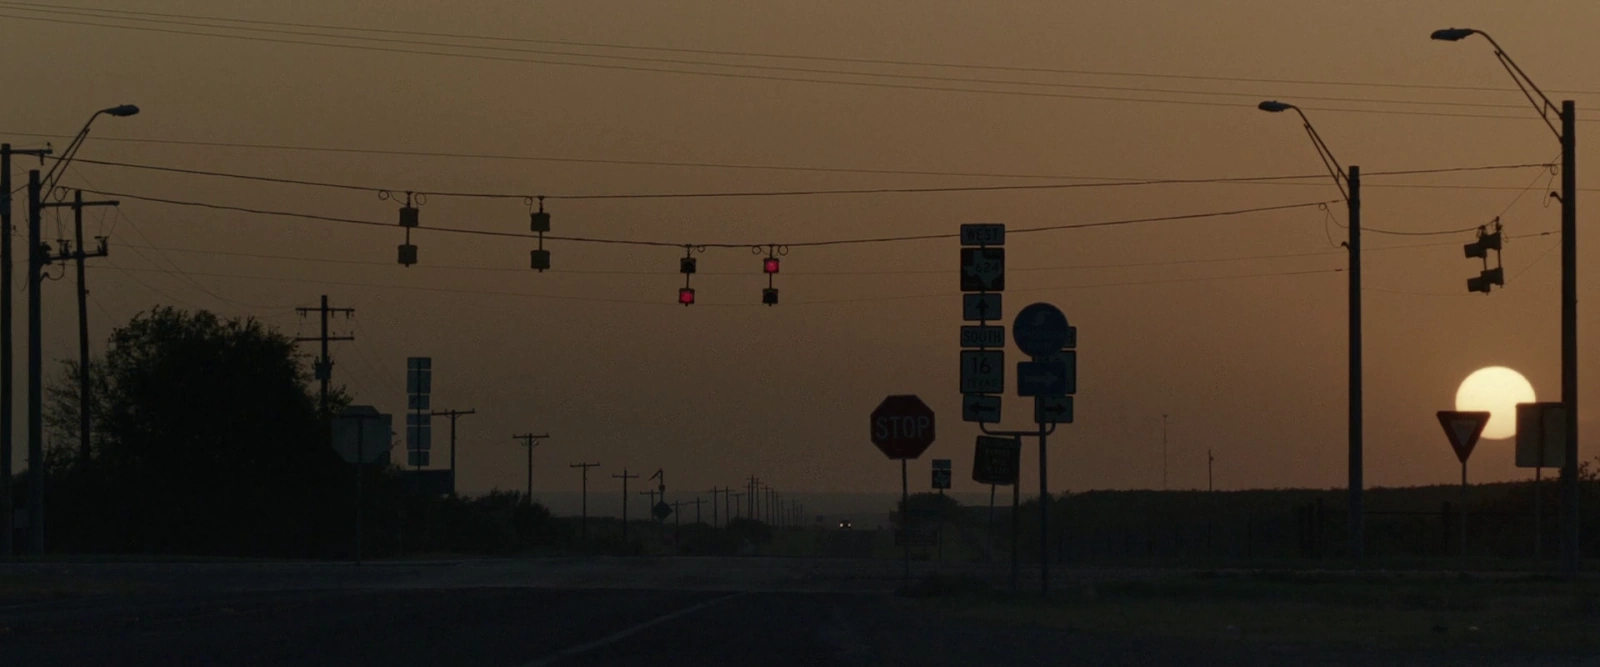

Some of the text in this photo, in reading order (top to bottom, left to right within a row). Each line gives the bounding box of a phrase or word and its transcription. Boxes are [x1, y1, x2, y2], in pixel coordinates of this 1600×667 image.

[966, 227, 999, 241] WEST
[975, 262, 999, 273] 624
[964, 330, 1001, 343] SOUTH
[972, 356, 991, 375] 16
[875, 415, 930, 439] STOP
